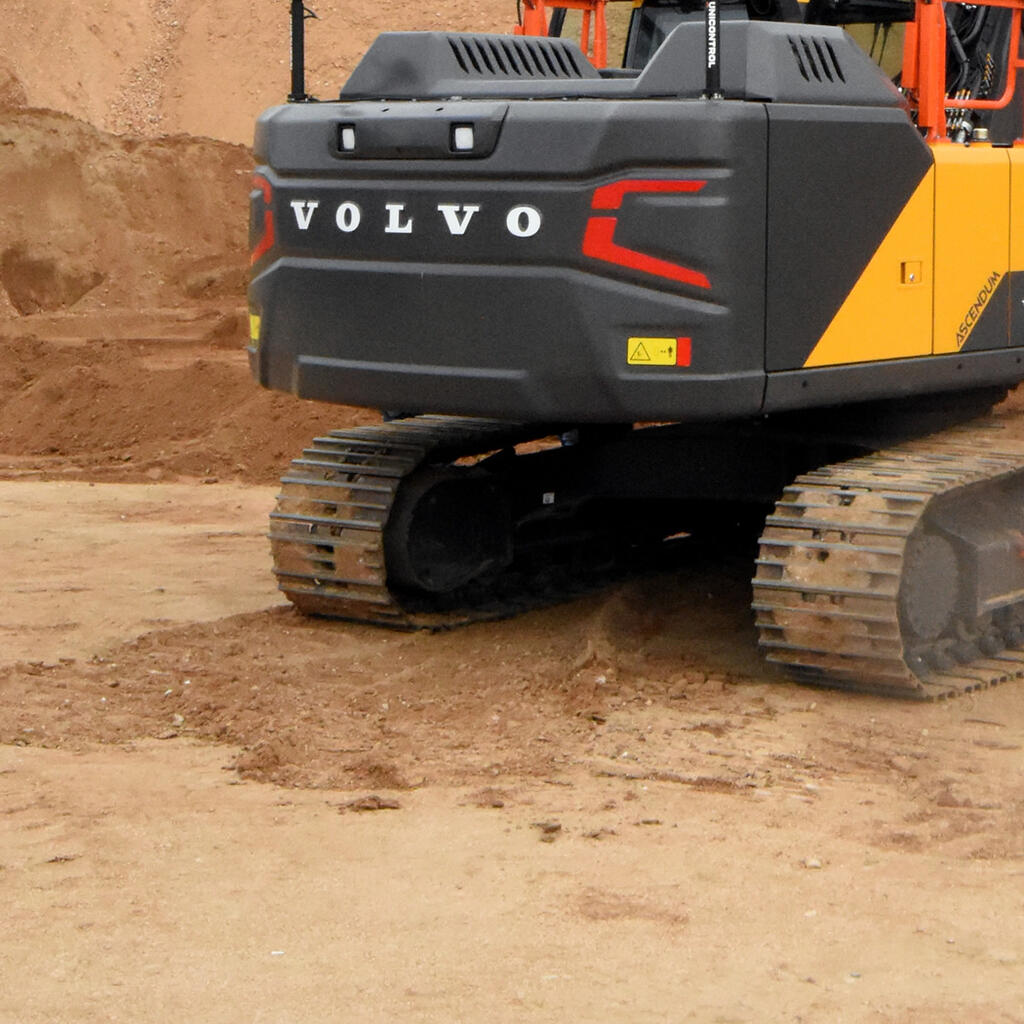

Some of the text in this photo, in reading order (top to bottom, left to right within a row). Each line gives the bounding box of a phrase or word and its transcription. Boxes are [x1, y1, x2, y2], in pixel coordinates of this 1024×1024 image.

[707, 1, 717, 69] UNICONTROL
[290, 200, 542, 238] VOLVO
[956, 271, 1001, 348] ASCENDUM
